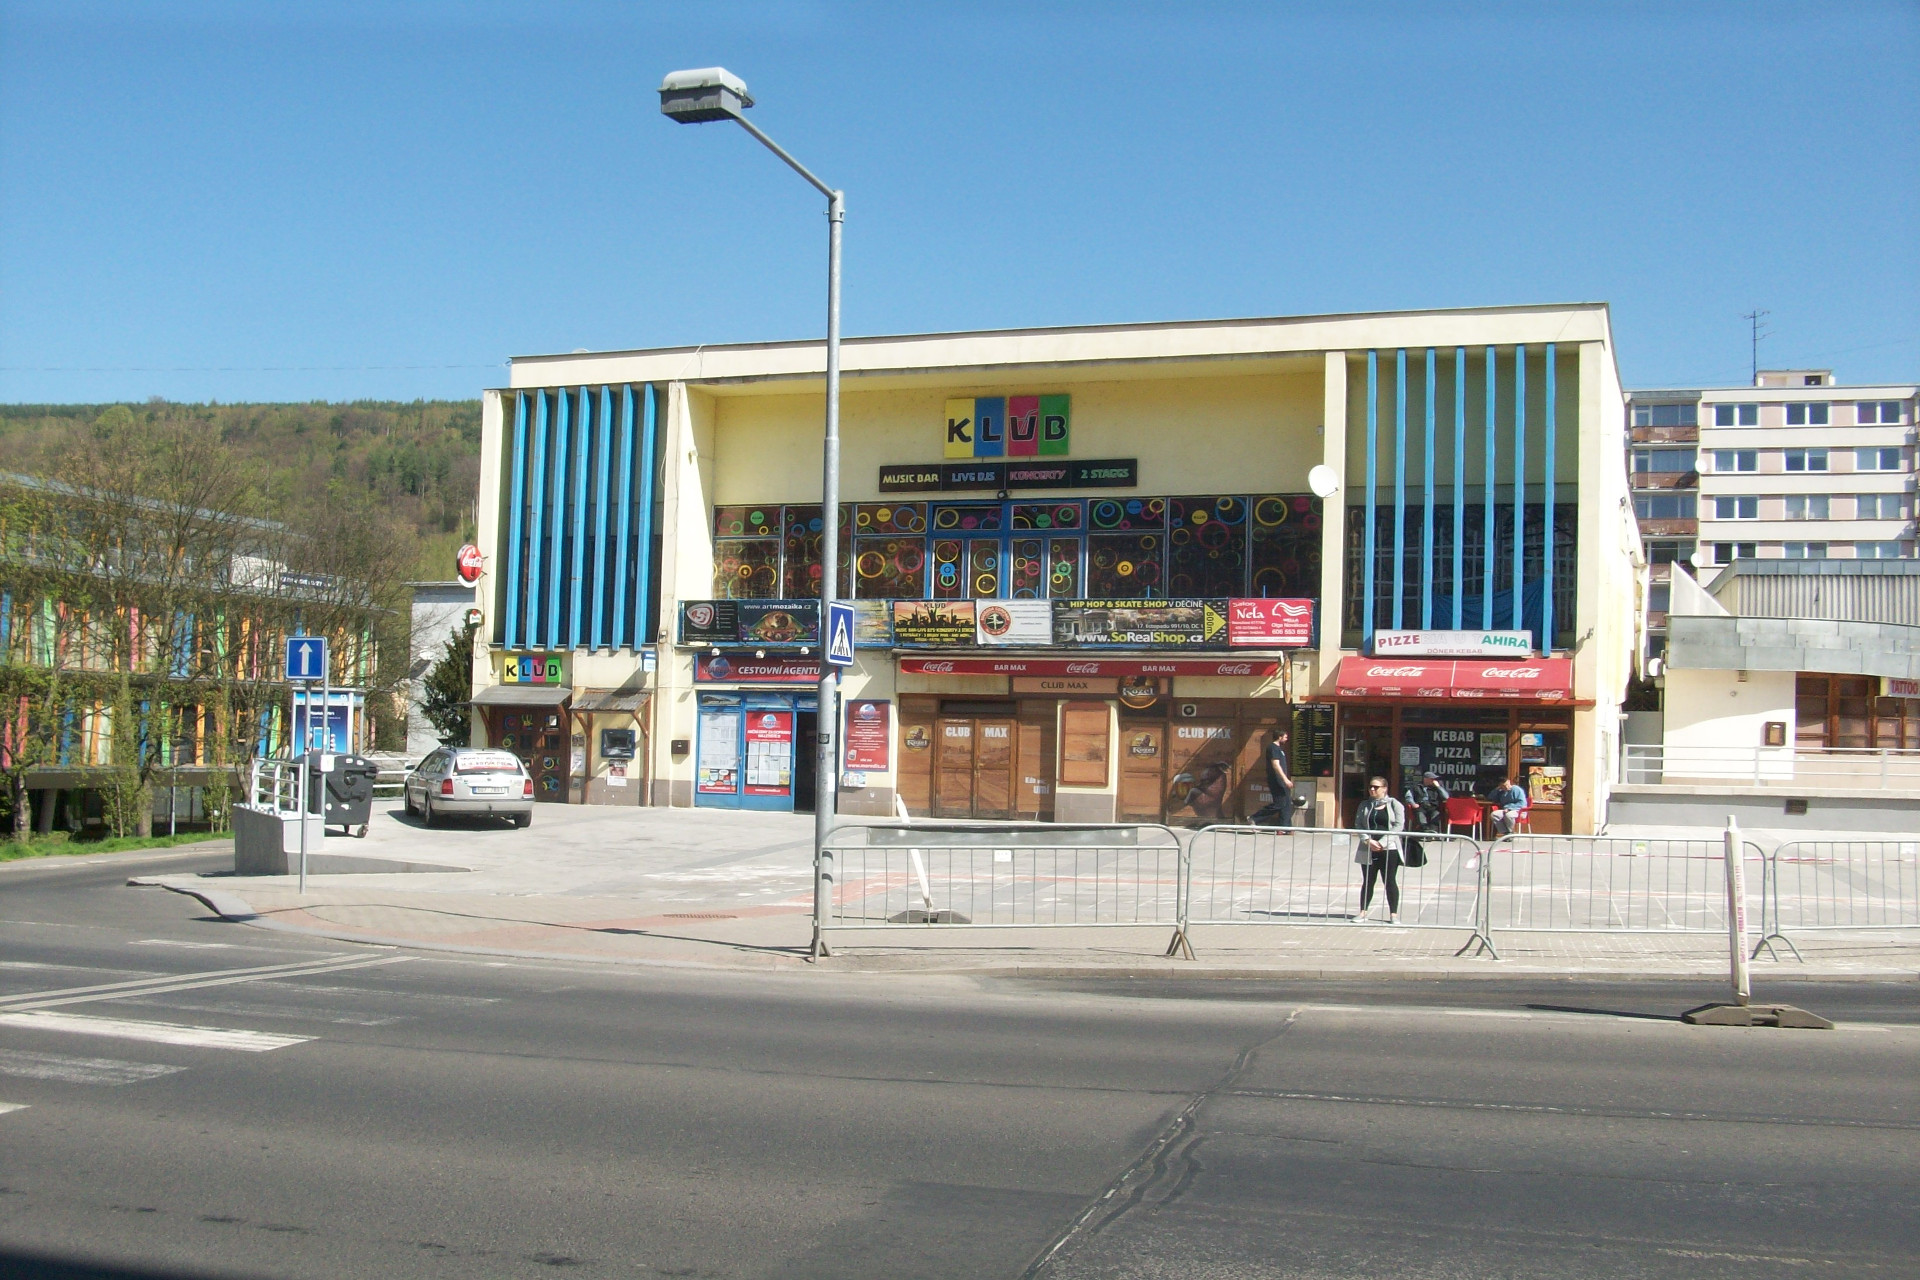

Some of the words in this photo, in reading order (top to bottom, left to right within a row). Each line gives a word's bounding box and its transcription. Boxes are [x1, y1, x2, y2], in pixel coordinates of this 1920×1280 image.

[947, 413, 1067, 442] KLUB
[882, 474, 915, 484] MUSIC
[917, 473, 939, 483] BAR
[951, 472, 976, 482] LIVE
[1009, 469, 1067, 480] KONCERTY
[1080, 469, 1088, 479] 2
[1090, 468, 1130, 478] STAGES
[1070, 600, 1085, 608] HIP
[1086, 600, 1105, 608] HOP
[1115, 600, 1141, 608] SKATE
[1143, 600, 1168, 608] SHOP
[1236, 606, 1265, 619] Nela
[1206, 611, 1215, 634] 800m
[1075, 631, 1204, 644] www.SoRealShop.cz
[506, 664, 558, 677] KLUB
[738, 665, 782, 675] CESTOVNÍ
[783, 666, 820, 675] AGENTU
[1040, 681, 1064, 689] CLUB
[1067, 681, 1088, 689] MAX
[945, 726, 971, 738] CLUB
[985, 727, 1008, 738] MAX
[1178, 727, 1204, 739] CLUB
[1206, 728, 1232, 739] MAX
[1433, 730, 1475, 742] KEBAB
[1435, 747, 1471, 759] PIZZA
[1429, 762, 1476, 775] DÜRÜM
[1438, 778, 1476, 792] ALÁTY
[1532, 776, 1562, 785] KEBAB
